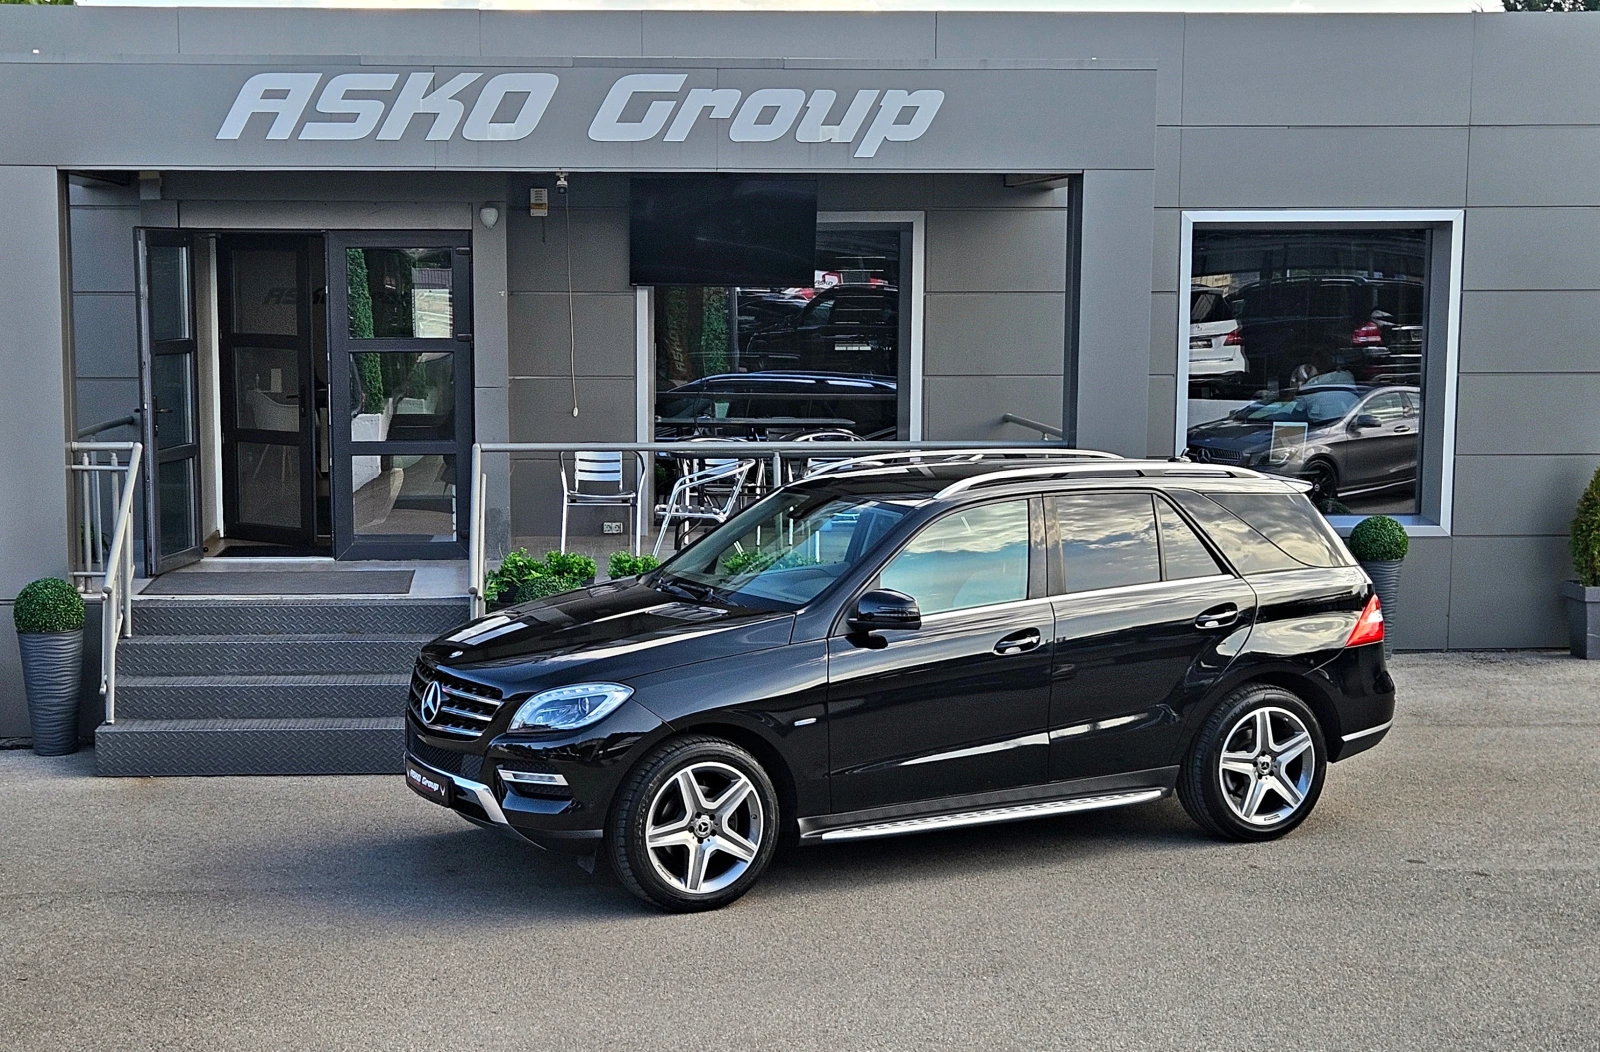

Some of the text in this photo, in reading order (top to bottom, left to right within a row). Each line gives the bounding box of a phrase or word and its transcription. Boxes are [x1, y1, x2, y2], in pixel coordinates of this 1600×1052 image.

[215, 72, 945, 158] ASKO Group
[422, 777, 439, 791] Group
